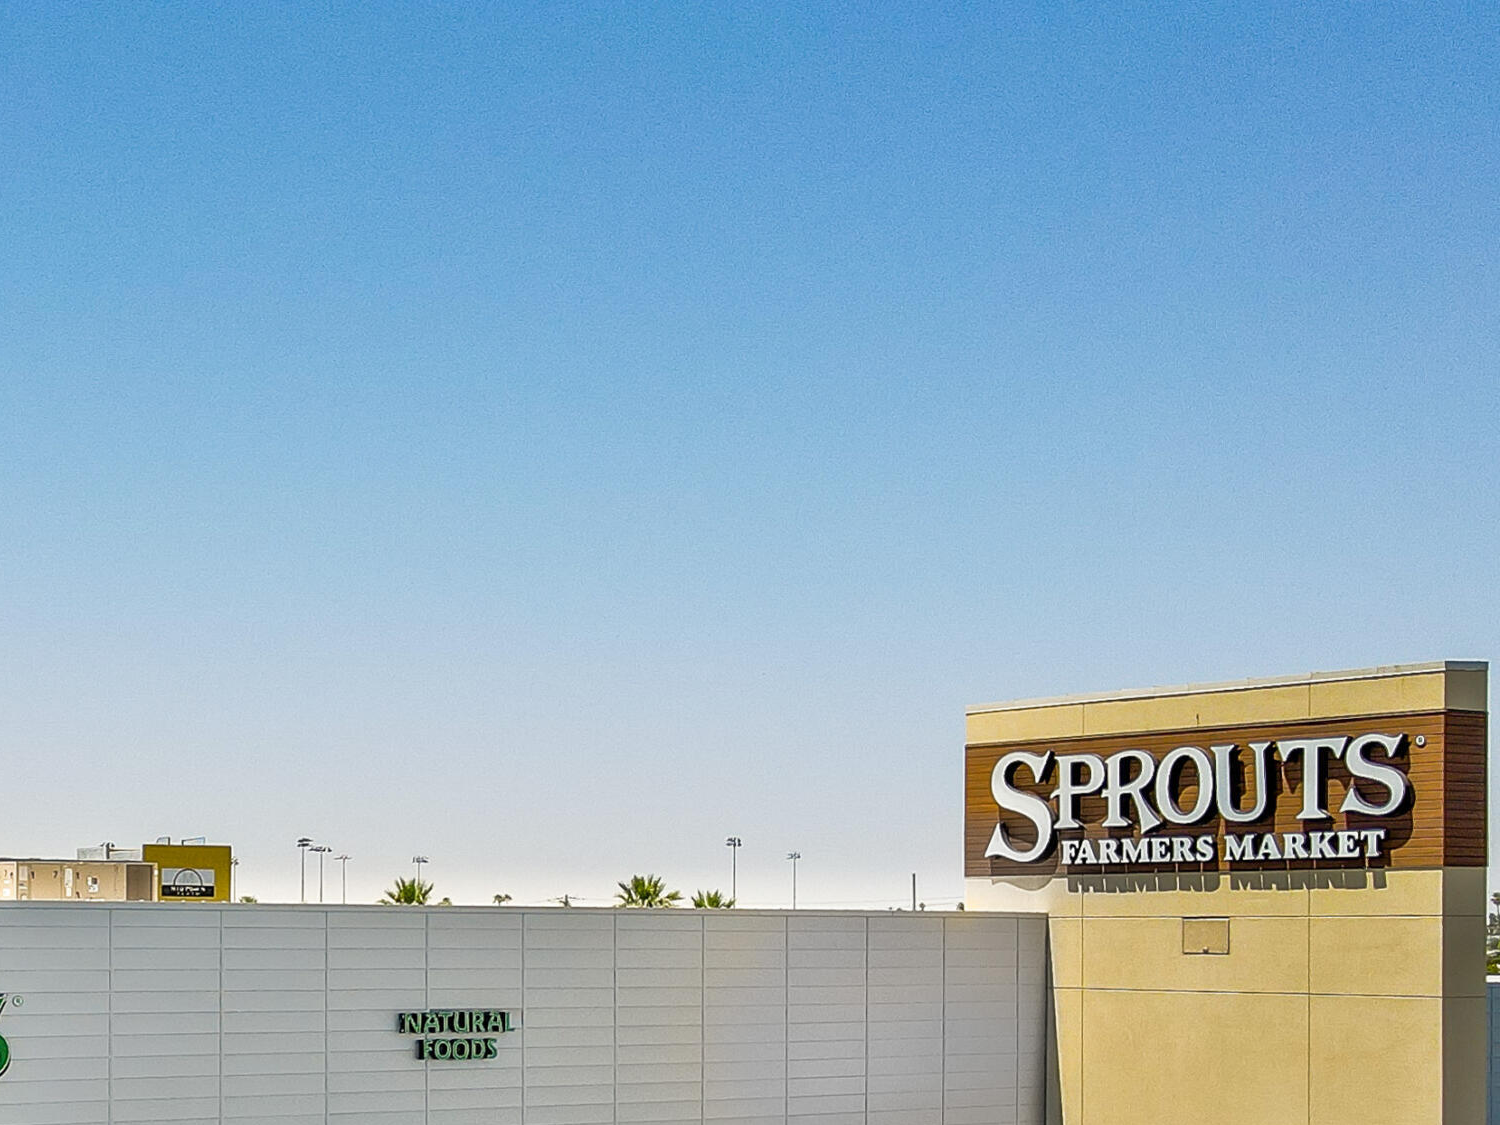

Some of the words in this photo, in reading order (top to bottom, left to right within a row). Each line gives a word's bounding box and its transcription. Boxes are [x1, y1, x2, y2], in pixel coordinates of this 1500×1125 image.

[984, 732, 1408, 864] SPROUTS
[1061, 834, 1214, 865] FARMERS
[1223, 829, 1386, 861] MARKET
[400, 1011, 516, 1034] NATURAL
[420, 1038, 498, 1060] FOODS
